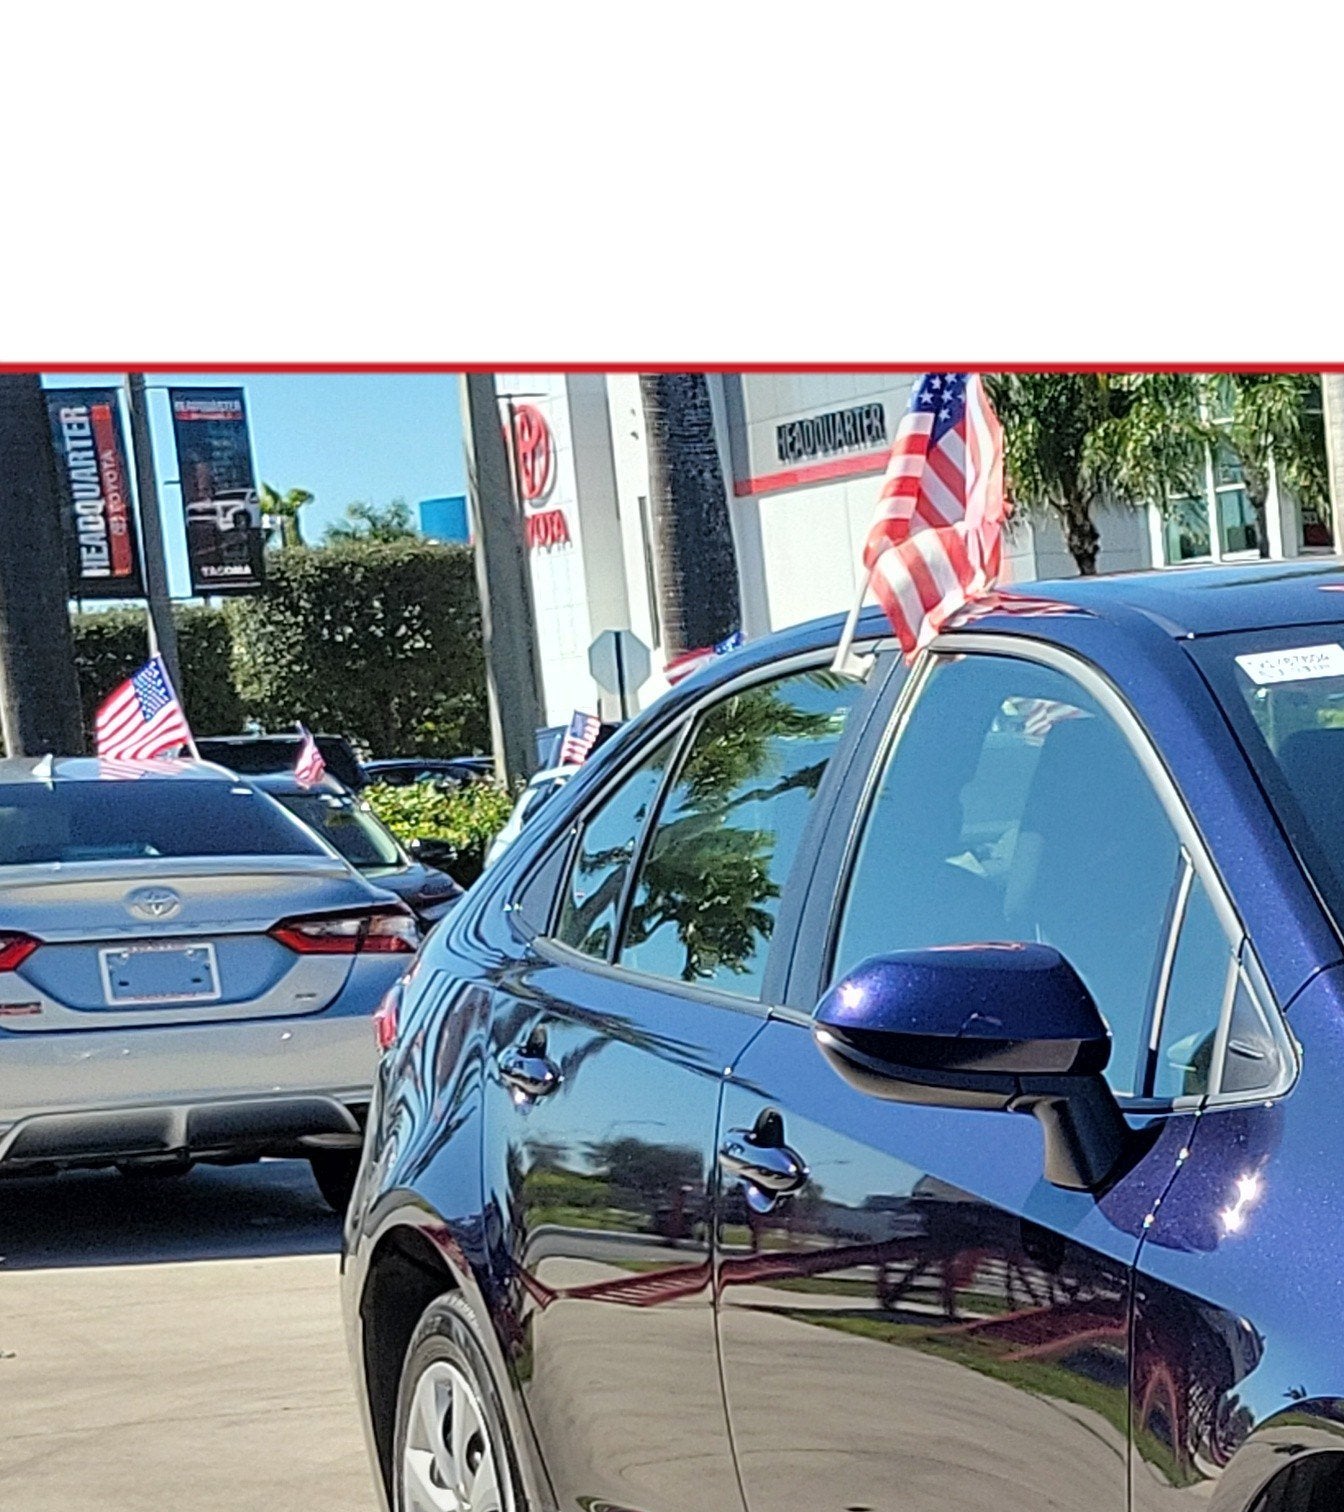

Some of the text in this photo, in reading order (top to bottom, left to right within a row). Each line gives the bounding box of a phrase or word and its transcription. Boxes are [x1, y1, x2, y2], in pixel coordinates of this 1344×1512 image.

[776, 403, 886, 460] HEADQUARTER
[60, 405, 111, 578] HEADQUARTER
[100, 450, 127, 514] TOYOTA
[201, 565, 251, 577] TACOMA
